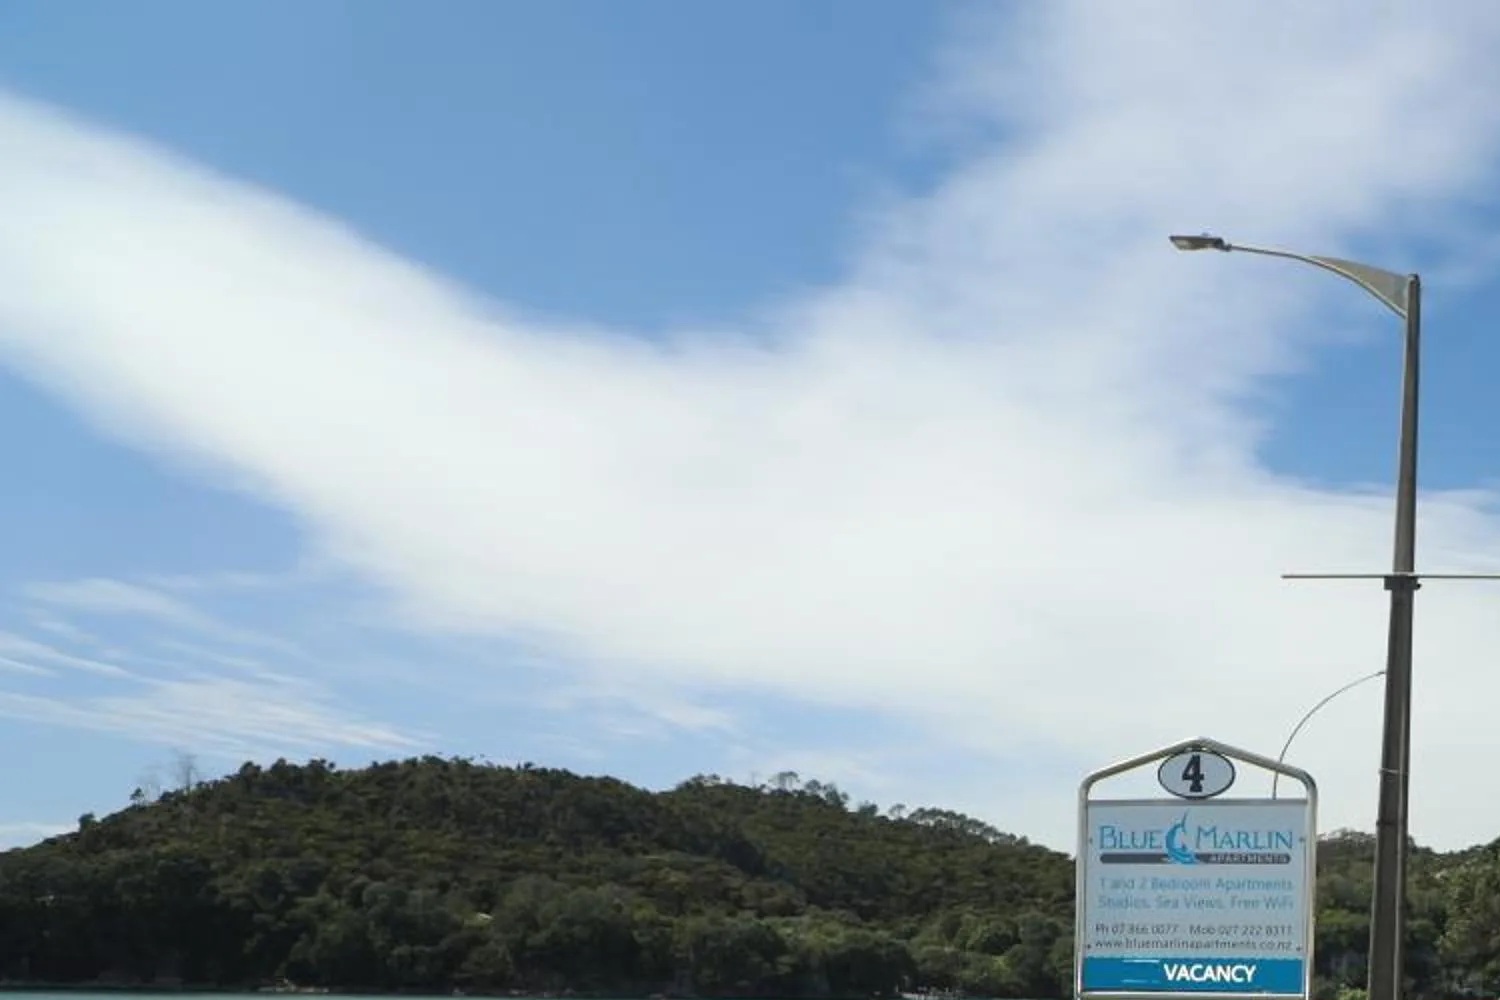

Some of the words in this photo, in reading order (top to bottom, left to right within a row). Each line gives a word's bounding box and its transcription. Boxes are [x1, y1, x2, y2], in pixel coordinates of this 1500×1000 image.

[1182, 754, 1205, 793] 4
[1196, 826, 1293, 849] MARLIN
[1110, 878, 1135, 890] and
[1139, 878, 1148, 890] 2
[1151, 877, 1211, 890] Bedroom
[1215, 877, 1293, 892] Apartments
[1157, 895, 1180, 909] Sea
[1229, 895, 1260, 909] Free
[1095, 923, 1109, 935] Ph
[1111, 923, 1127, 935] 07
[1189, 924, 1216, 936] Mob
[1163, 963, 1256, 983] VACANCY
